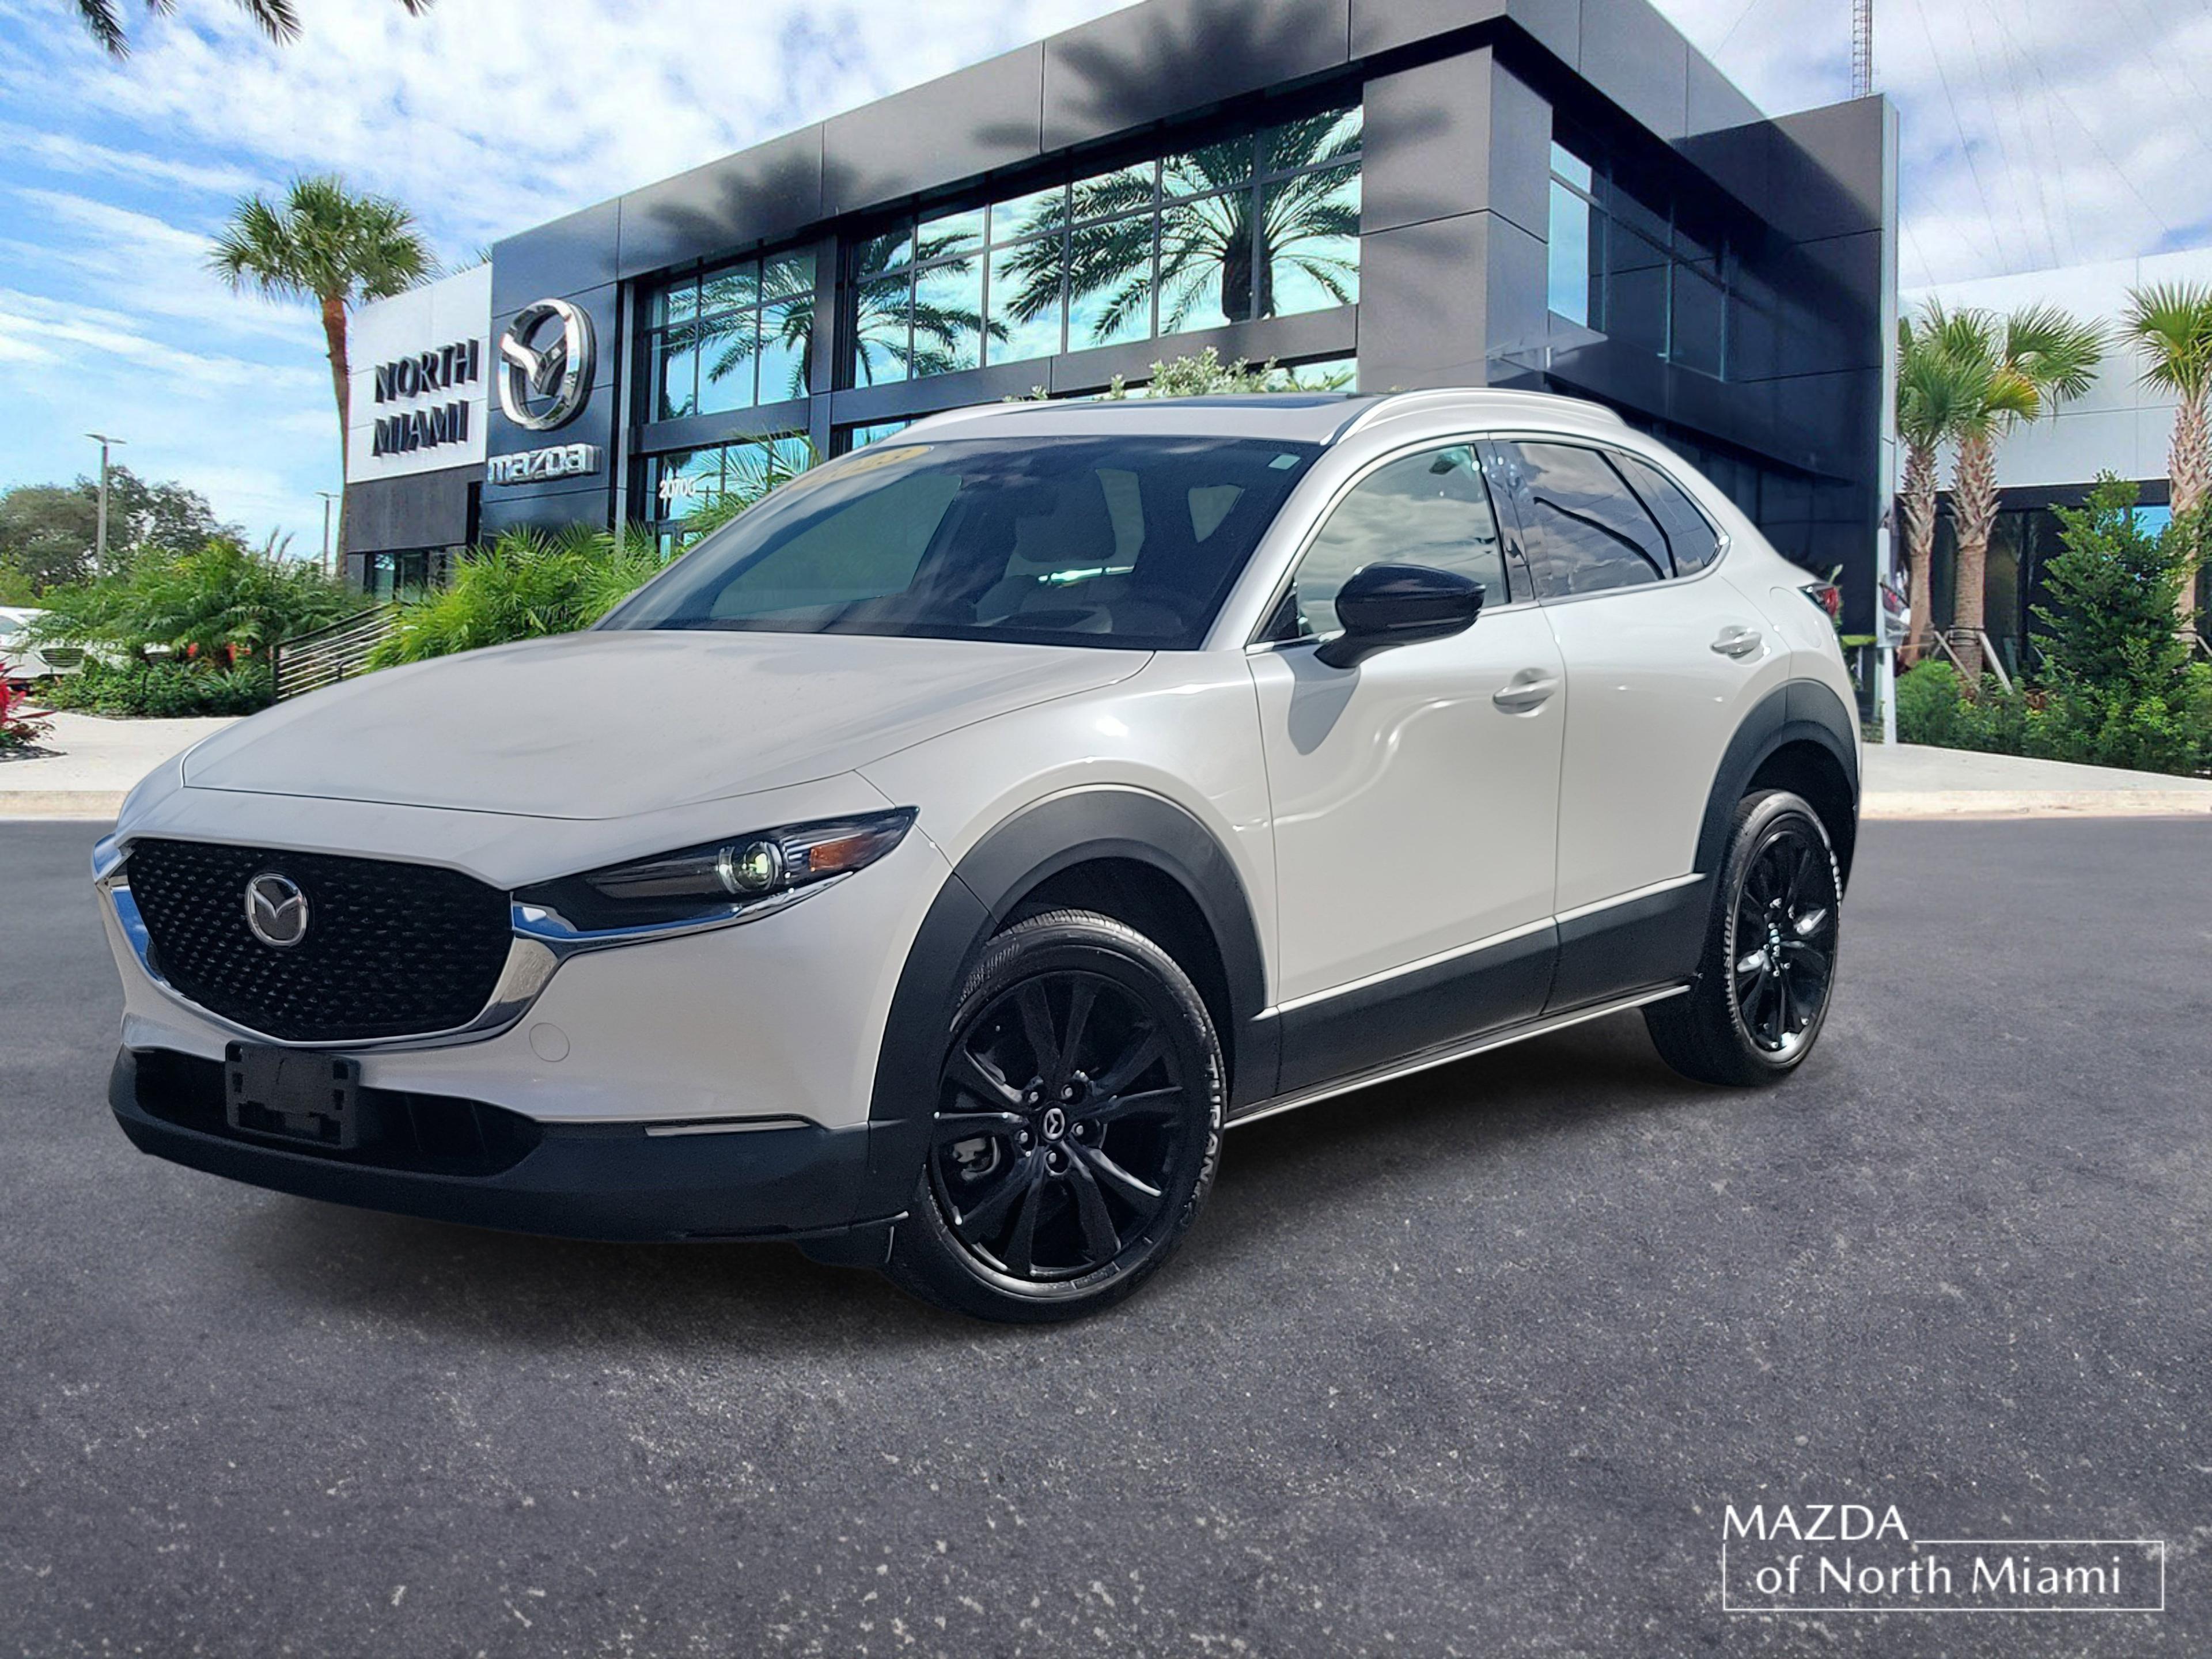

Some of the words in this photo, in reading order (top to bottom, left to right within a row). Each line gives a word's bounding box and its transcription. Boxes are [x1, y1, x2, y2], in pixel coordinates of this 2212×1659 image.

[375, 339, 479, 404] NORTH
[372, 399, 469, 457] MIAMI
[488, 443, 600, 484] mazda
